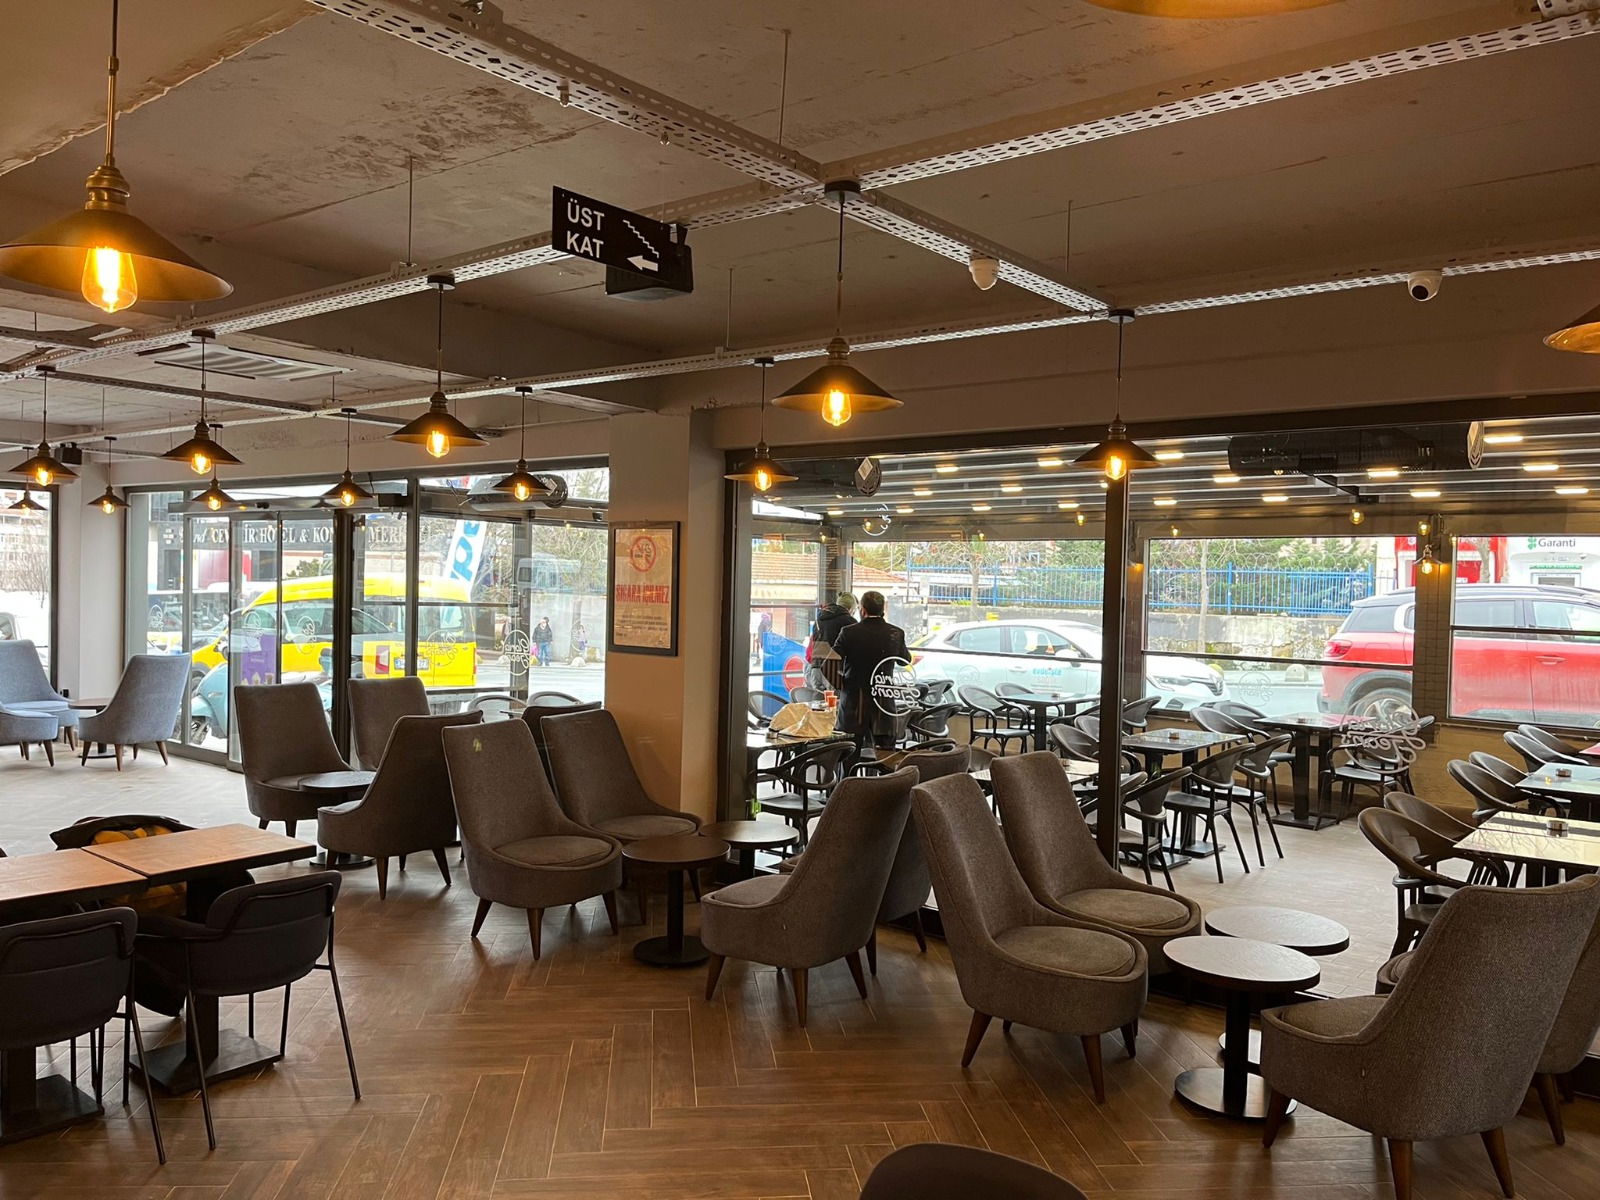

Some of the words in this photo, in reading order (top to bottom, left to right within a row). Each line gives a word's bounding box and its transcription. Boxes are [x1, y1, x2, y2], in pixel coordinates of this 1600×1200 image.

[567, 198, 605, 231] ÜST
[566, 230, 604, 259] KAT
[260, 527, 296, 543] HOEL
[1538, 538, 1576, 548] Garanti
